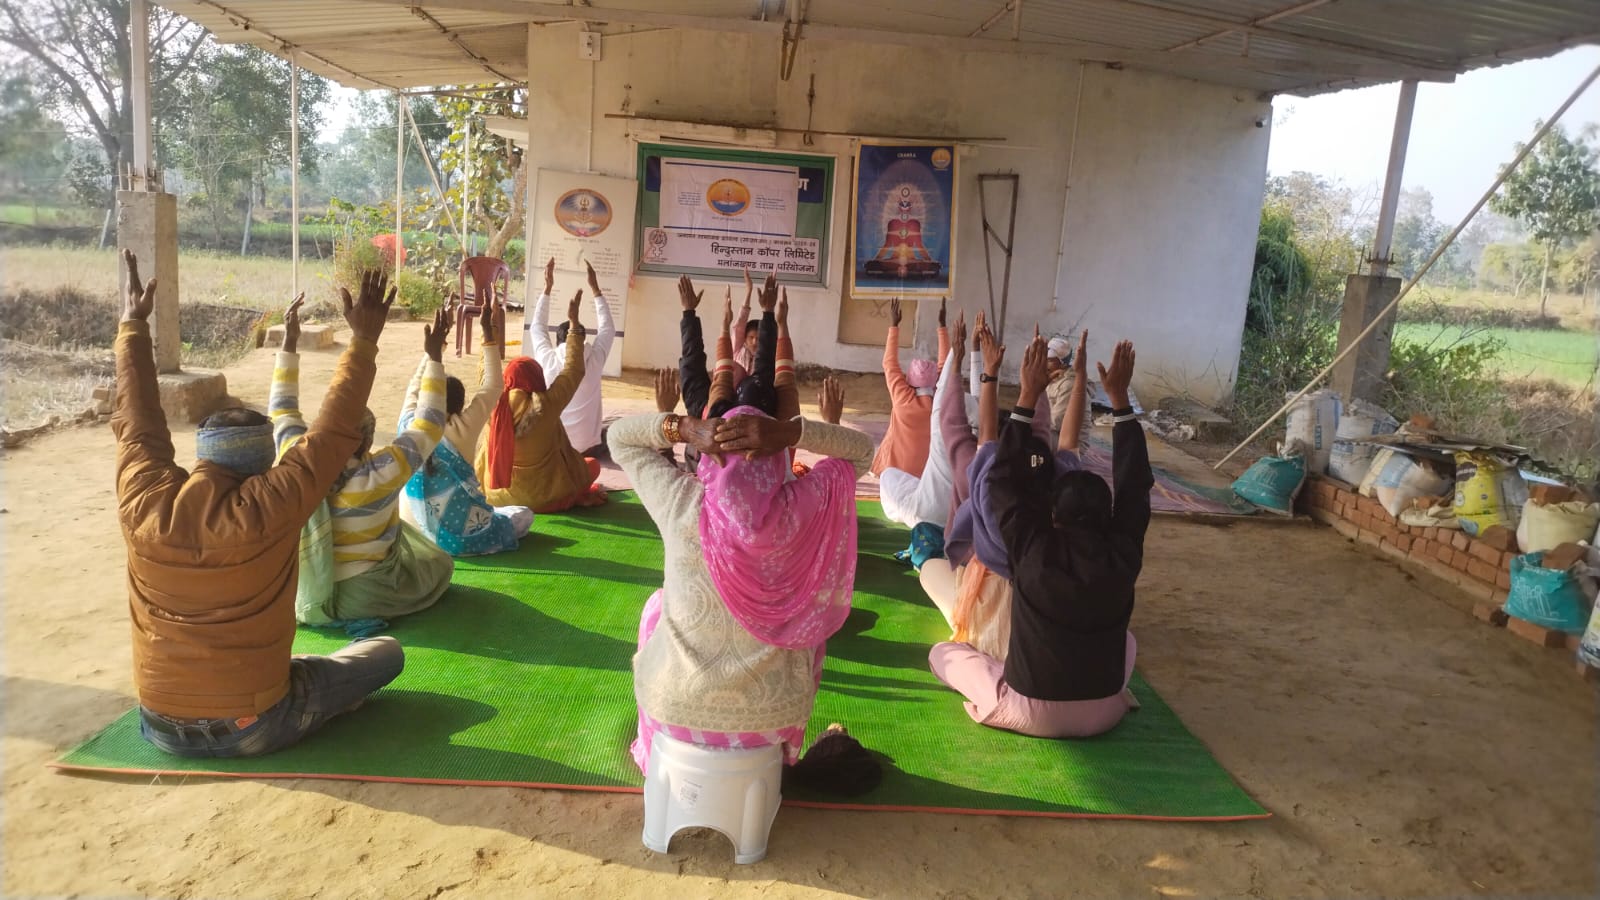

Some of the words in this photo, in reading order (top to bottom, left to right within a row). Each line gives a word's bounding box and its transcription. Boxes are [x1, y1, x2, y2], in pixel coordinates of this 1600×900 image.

[712, 242, 753, 257] हिन्दुस्तान
[757, 246, 781, 258] कॉपर
[784, 247, 816, 260] लिमिटेड
